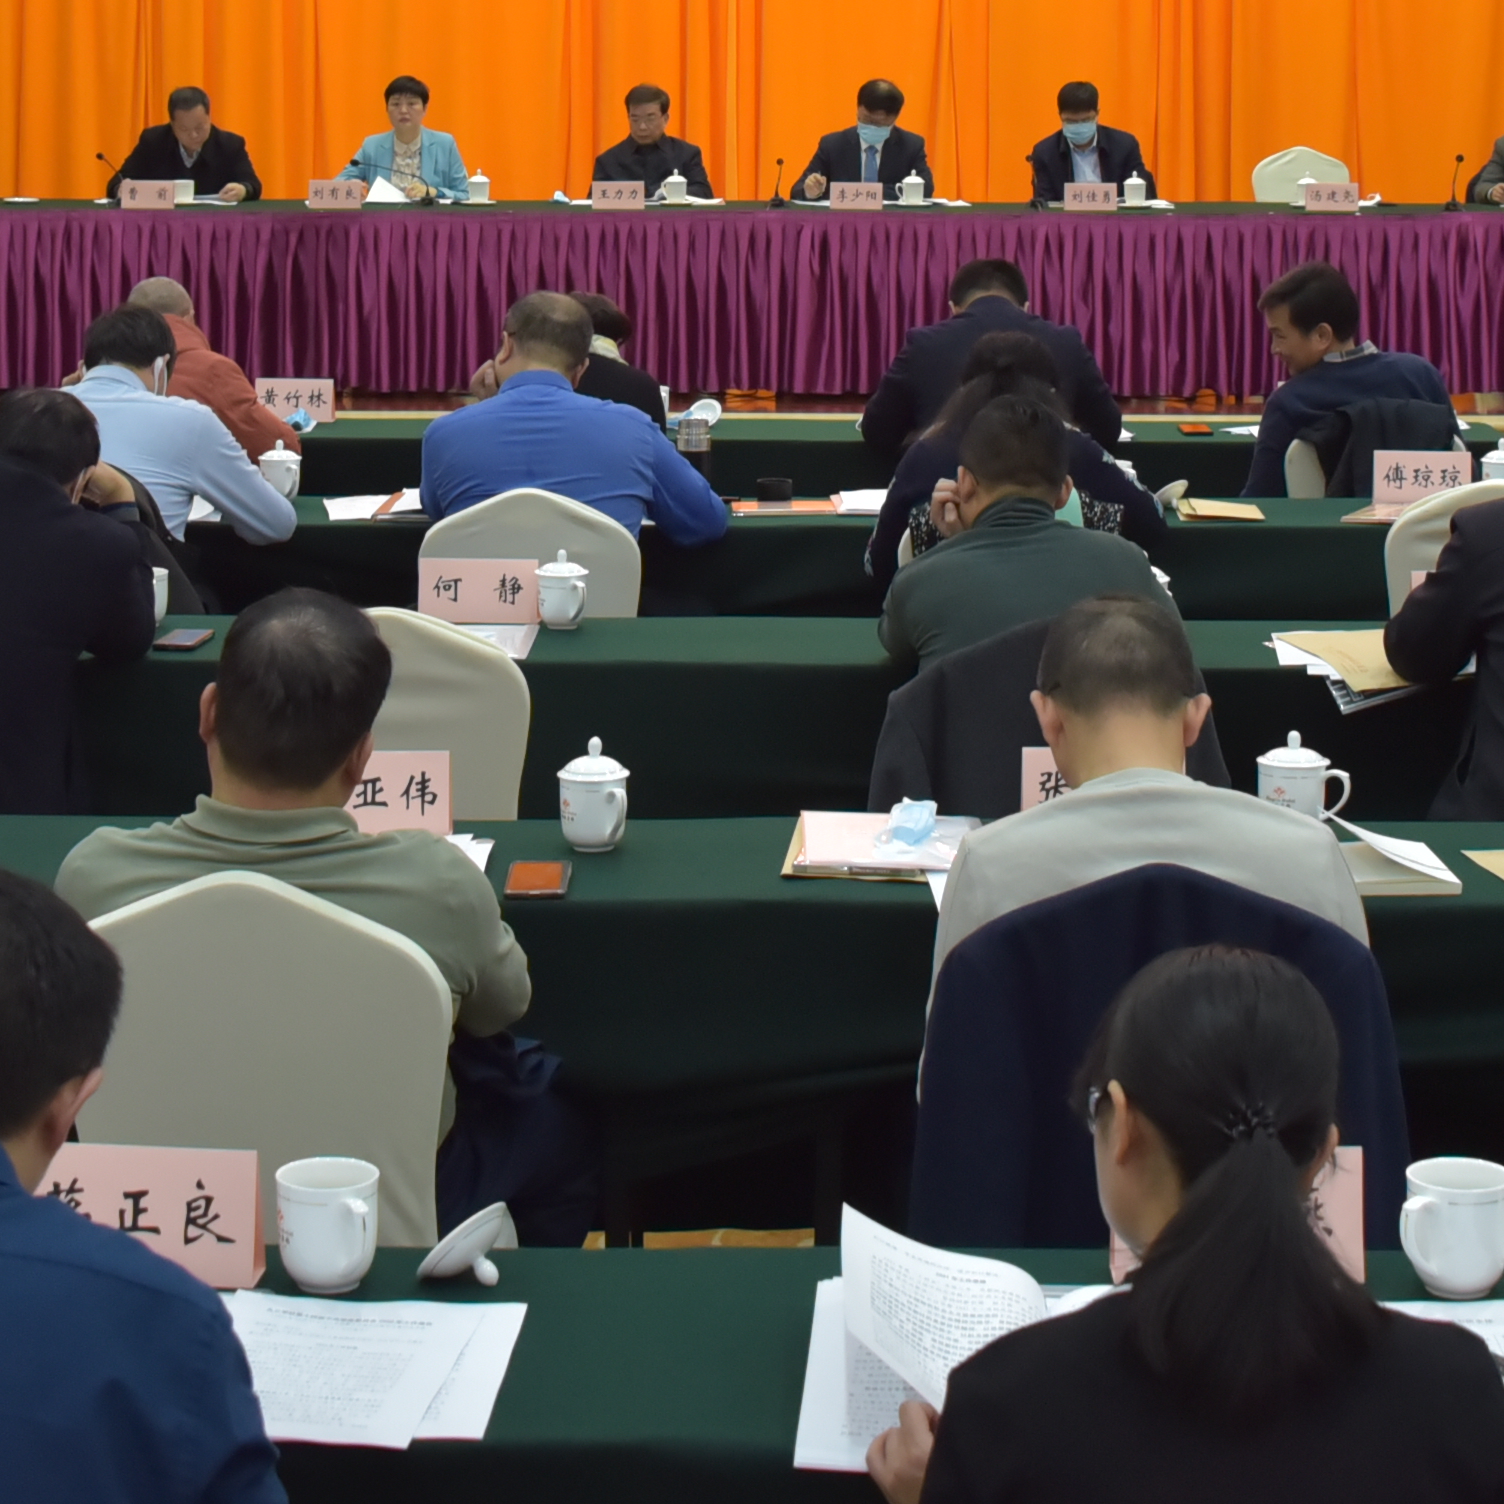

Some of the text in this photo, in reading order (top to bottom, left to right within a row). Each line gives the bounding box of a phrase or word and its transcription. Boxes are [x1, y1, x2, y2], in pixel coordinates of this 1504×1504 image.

[836, 187, 878, 203] 李少阳
[260, 386, 327, 408] 黄竹林
[1382, 462, 1463, 490] 傅琼琼
[433, 573, 524, 605] 何静
